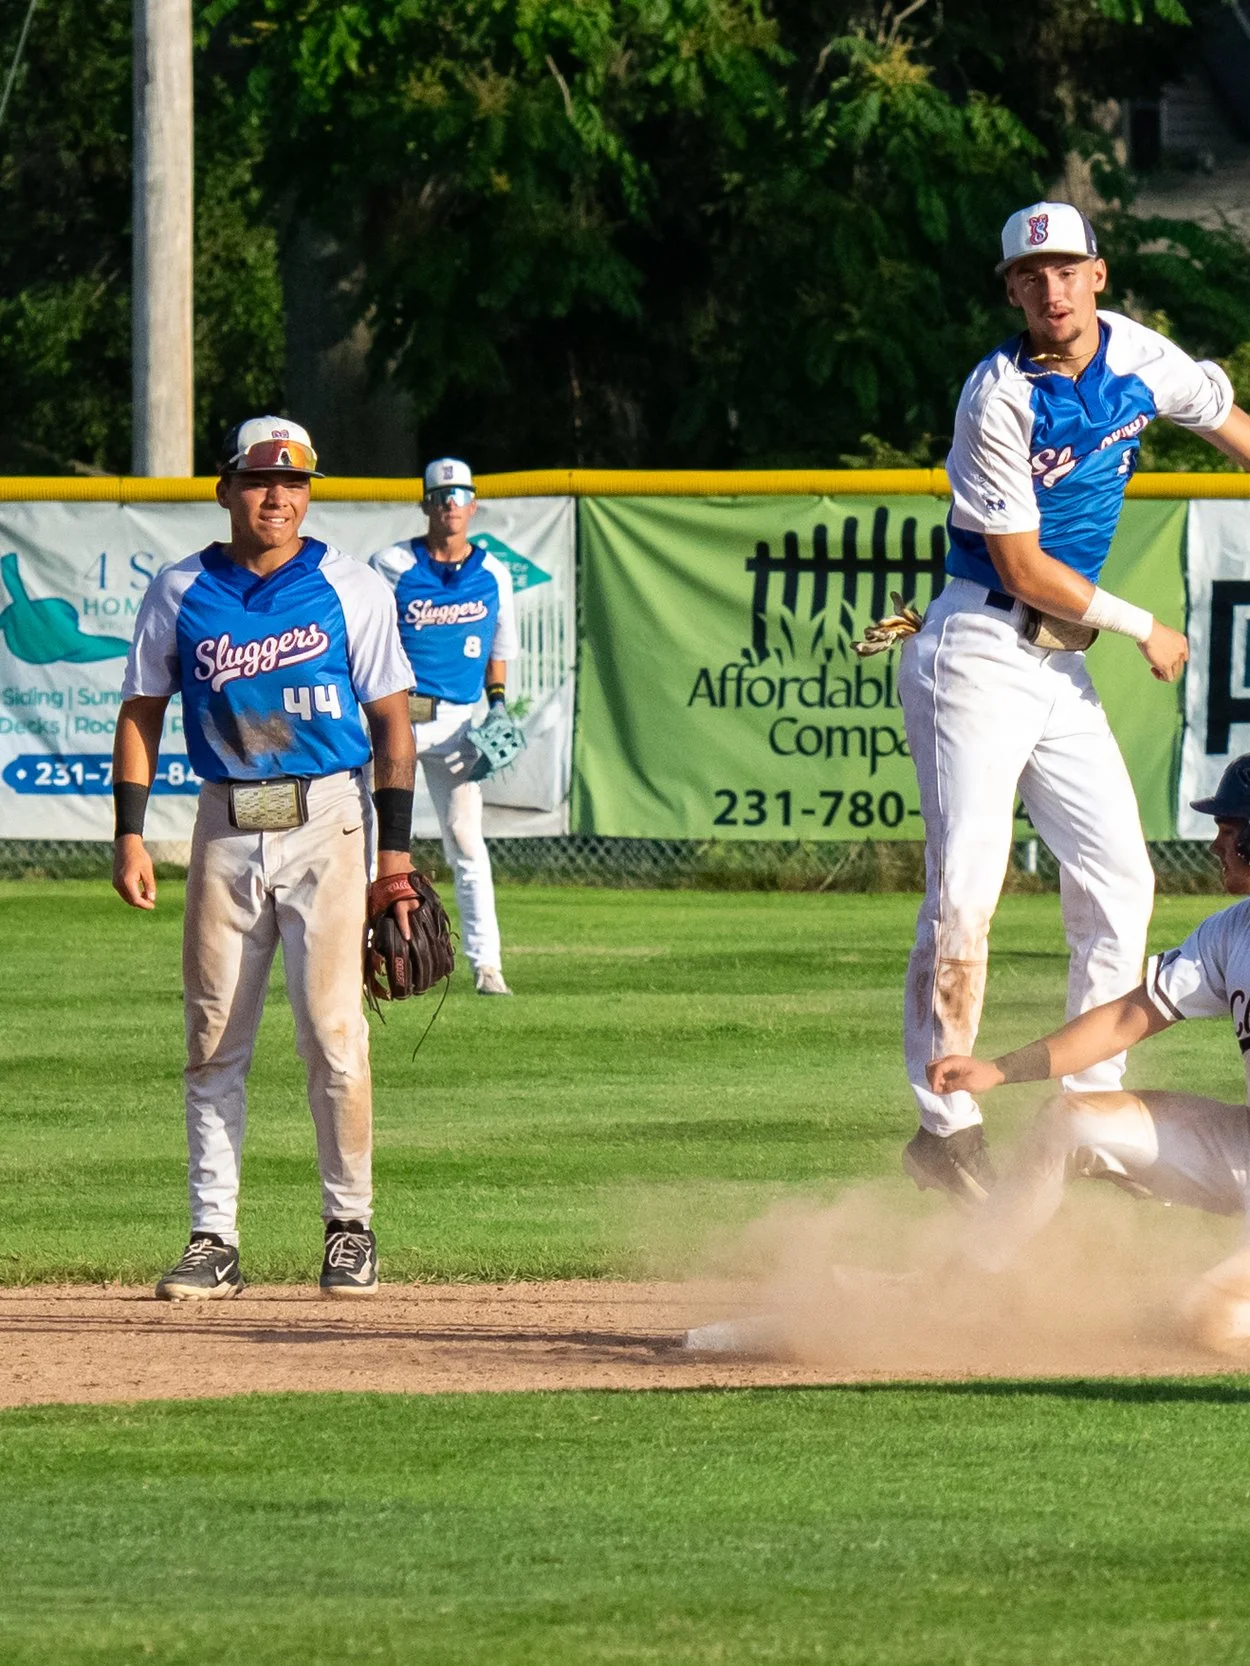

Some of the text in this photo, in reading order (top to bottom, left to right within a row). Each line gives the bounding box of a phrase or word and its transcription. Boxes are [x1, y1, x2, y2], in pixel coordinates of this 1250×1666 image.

[129, 550, 176, 590] S
[404, 599, 489, 632] Sluggers
[193, 622, 330, 693] Sluggers
[463, 635, 482, 659] 8
[2, 687, 65, 709] Siding
[282, 683, 342, 721] 44
[687, 662, 903, 710] Affordabl
[0, 716, 61, 735] Decks
